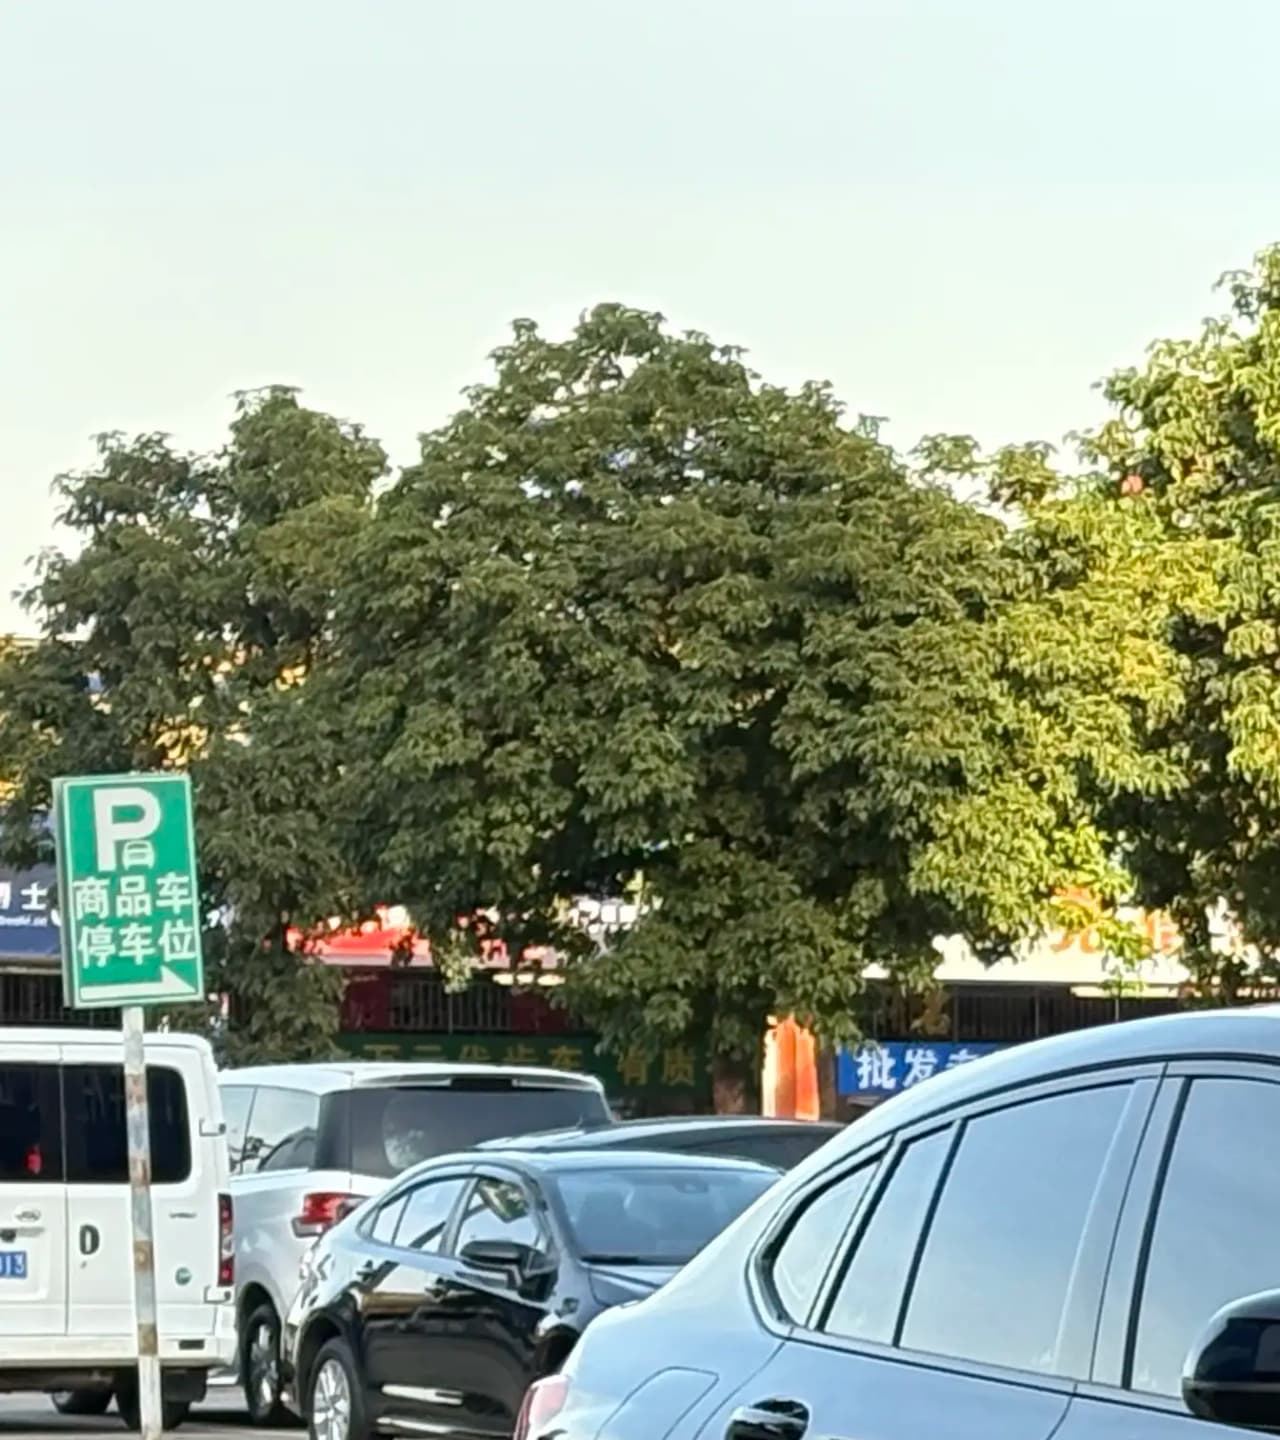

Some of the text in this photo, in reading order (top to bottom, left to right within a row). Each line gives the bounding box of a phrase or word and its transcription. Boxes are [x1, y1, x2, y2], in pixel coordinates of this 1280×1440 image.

[93, 787, 162, 873] P
[72, 871, 193, 920] 商品车
[78, 919, 198, 969] 停车位
